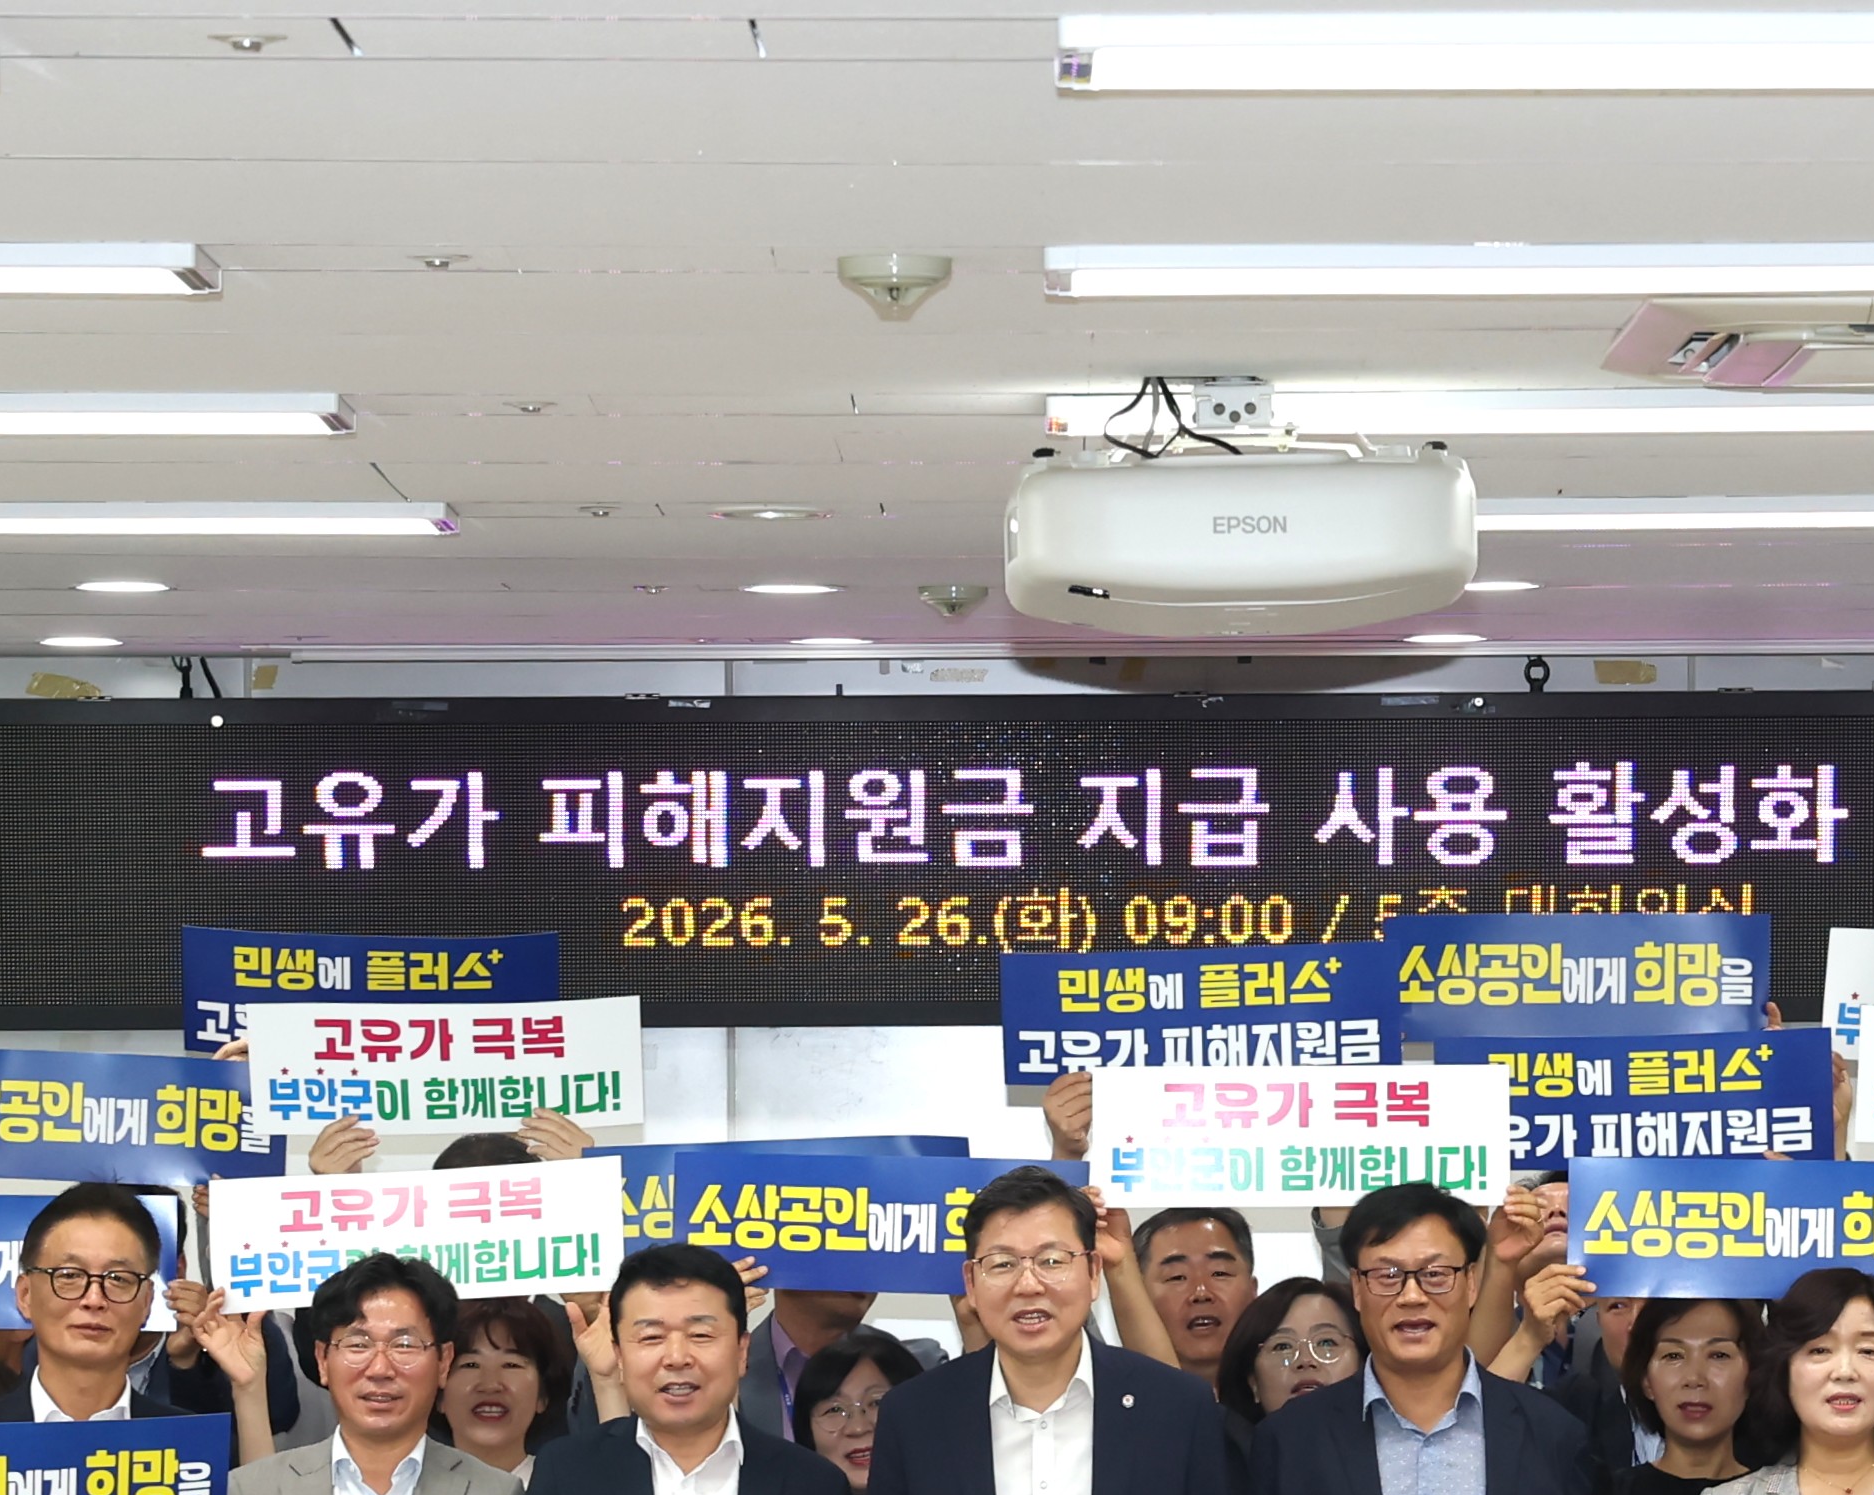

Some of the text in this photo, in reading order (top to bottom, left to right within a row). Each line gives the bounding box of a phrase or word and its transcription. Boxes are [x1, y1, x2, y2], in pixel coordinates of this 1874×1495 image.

[1213, 516, 1287, 534] EPSON
[202, 771, 499, 868] 고유가
[539, 770, 1033, 868] 피해지원금
[1081, 767, 1269, 867] 지급
[1314, 767, 1508, 867] 사용
[1548, 763, 1847, 864] 활성화
[623, 897, 790, 948] 2026.
[820, 897, 873, 947] 5.
[896, 887, 1096, 953] 26.(화)
[1124, 895, 1292, 945] 09:00
[234, 947, 350, 989] 민생에
[1059, 968, 1183, 1012] 민생에
[1400, 942, 1752, 1006] 소상공인에게 희망을
[315, 1016, 564, 1062] 고유가 극복
[1019, 1020, 1379, 1073] 고유가 피해지원금
[155, 1084, 271, 1153] 희망을
[270, 1072, 620, 1123] 부안군이 함께합니다!
[1161, 1082, 1430, 1127] 고유가 극복
[1590, 1107, 1812, 1157] 피해지원금
[1111, 1146, 1486, 1192] 부안군이 함께합니다!
[281, 1177, 541, 1232] 고유가 극복
[688, 1185, 936, 1253] 소상공인에게
[1585, 1191, 1834, 1259] 소상공인에게
